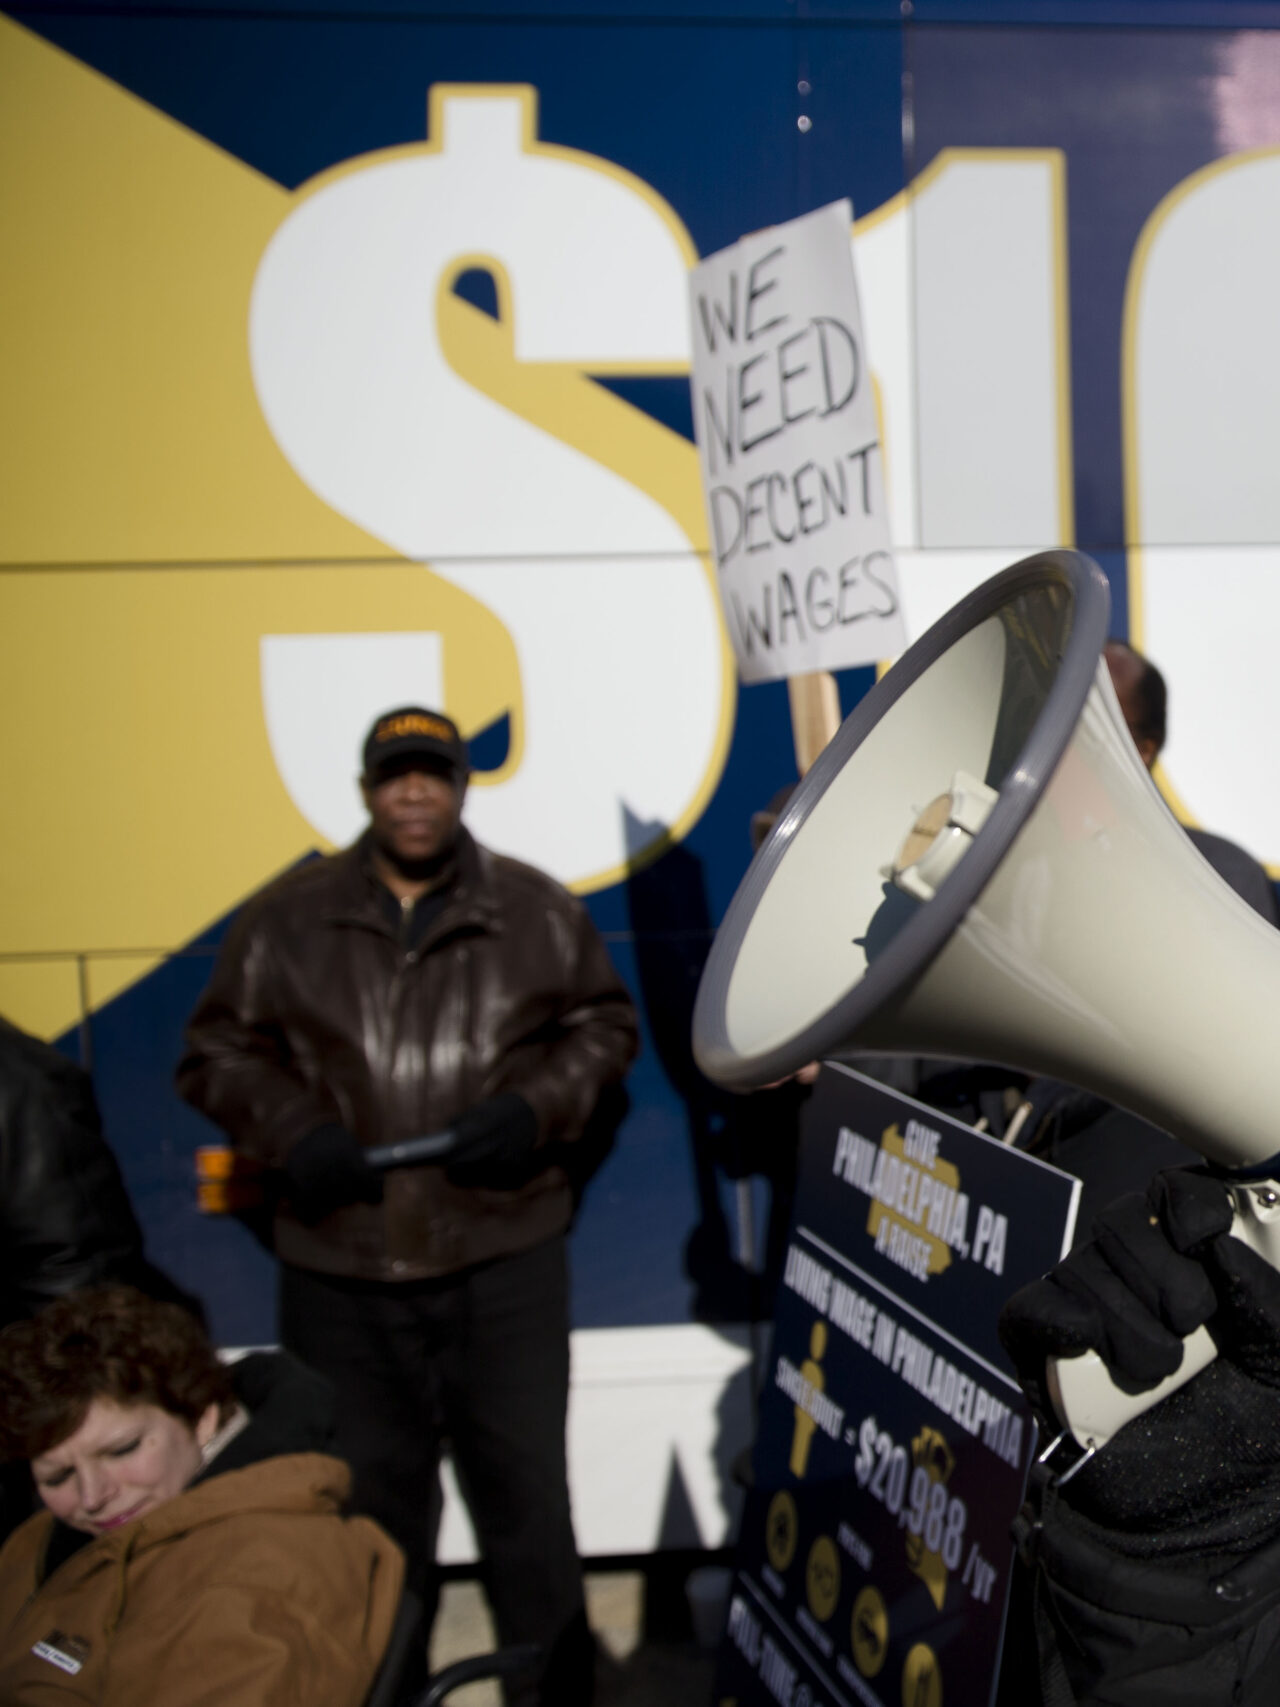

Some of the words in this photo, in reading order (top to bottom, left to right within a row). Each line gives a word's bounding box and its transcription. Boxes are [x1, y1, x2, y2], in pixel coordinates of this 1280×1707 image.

[699, 245, 791, 354] WE
[703, 316, 860, 477] NEED
[710, 441, 880, 568] DECENT
[732, 550, 898, 658] WAGES
[832, 1126, 970, 1260] PHILADELPHIA,
[971, 1204, 1009, 1277] PA
[891, 1326, 1024, 1471] PHILADELPHIA
[854, 1414, 968, 1572] $20,988
